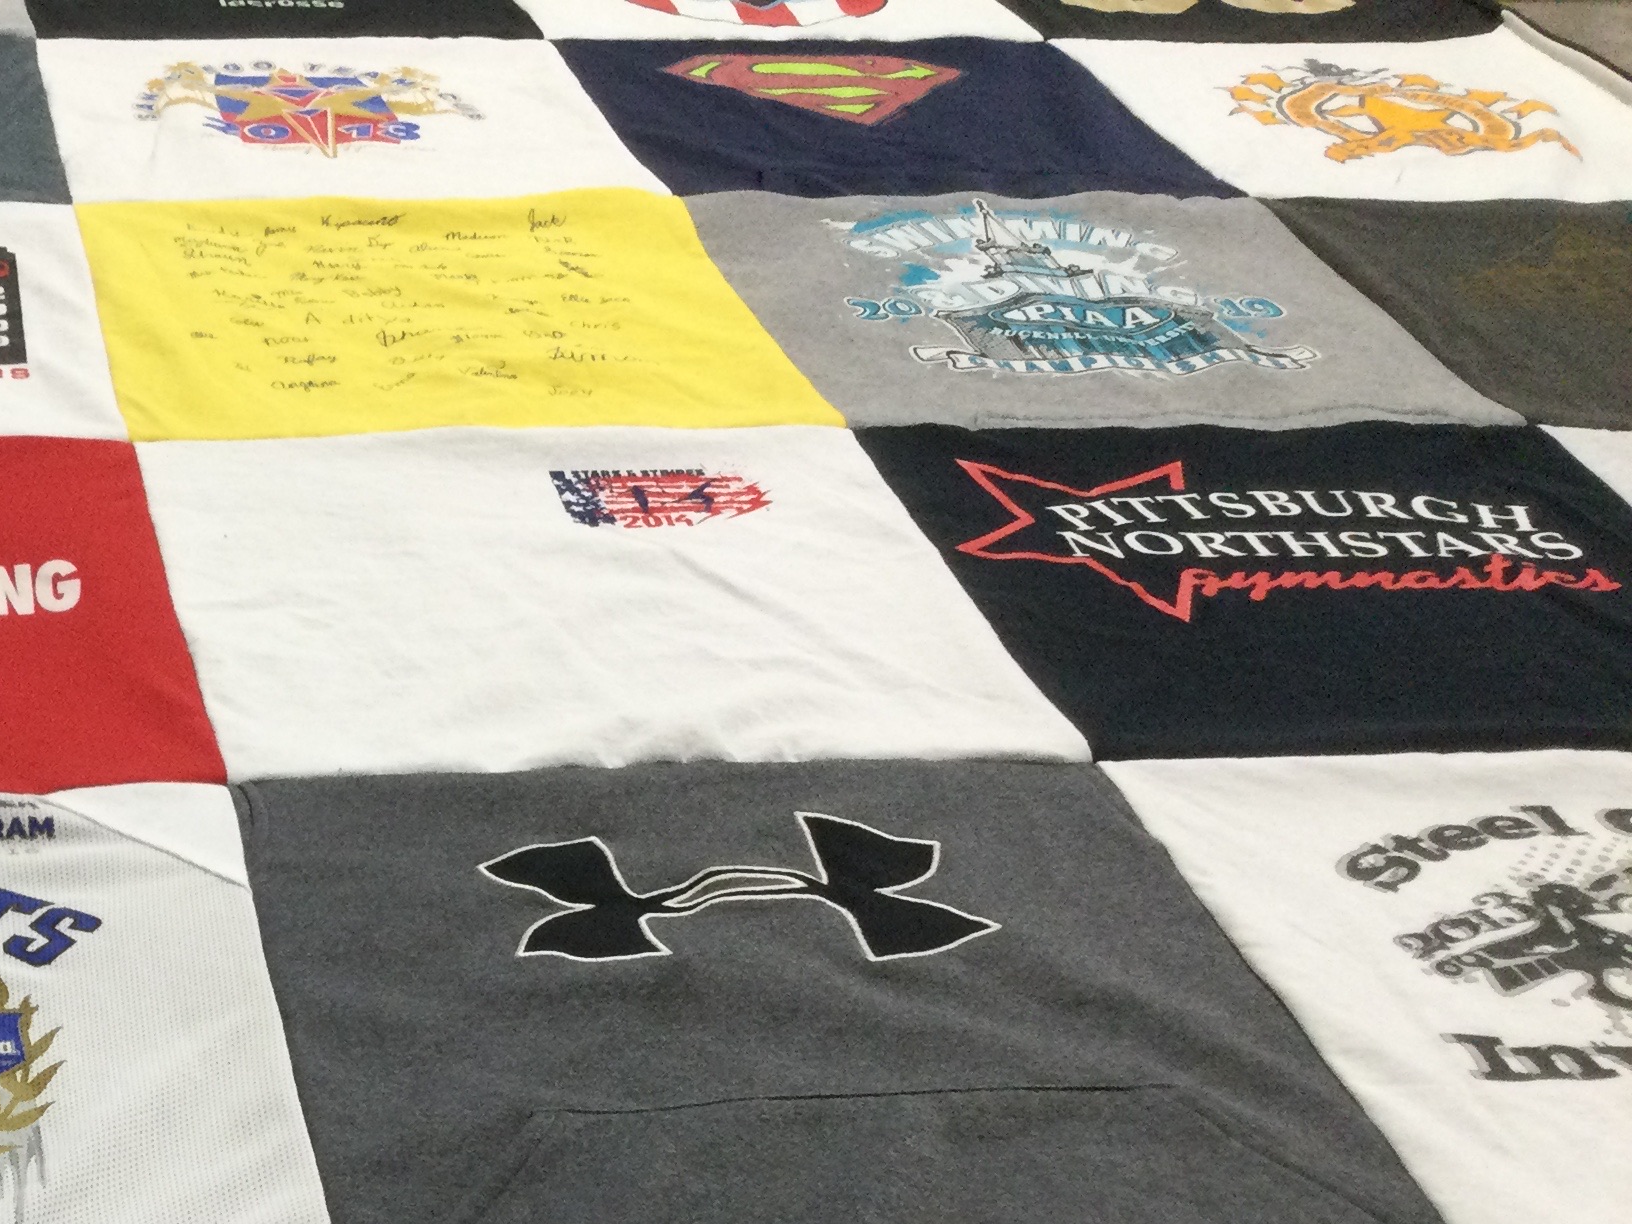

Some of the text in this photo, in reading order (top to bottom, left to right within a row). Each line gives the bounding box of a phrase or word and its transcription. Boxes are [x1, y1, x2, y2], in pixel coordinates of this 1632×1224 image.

[844, 215, 1180, 262] SWIMMING
[970, 272, 1202, 306] DIVING
[1025, 304, 1158, 329] PIAA
[1045, 488, 1536, 533] PITTSBURGH
[1054, 529, 1585, 562] NORTHSTARS
[1335, 805, 1590, 893] Steel
